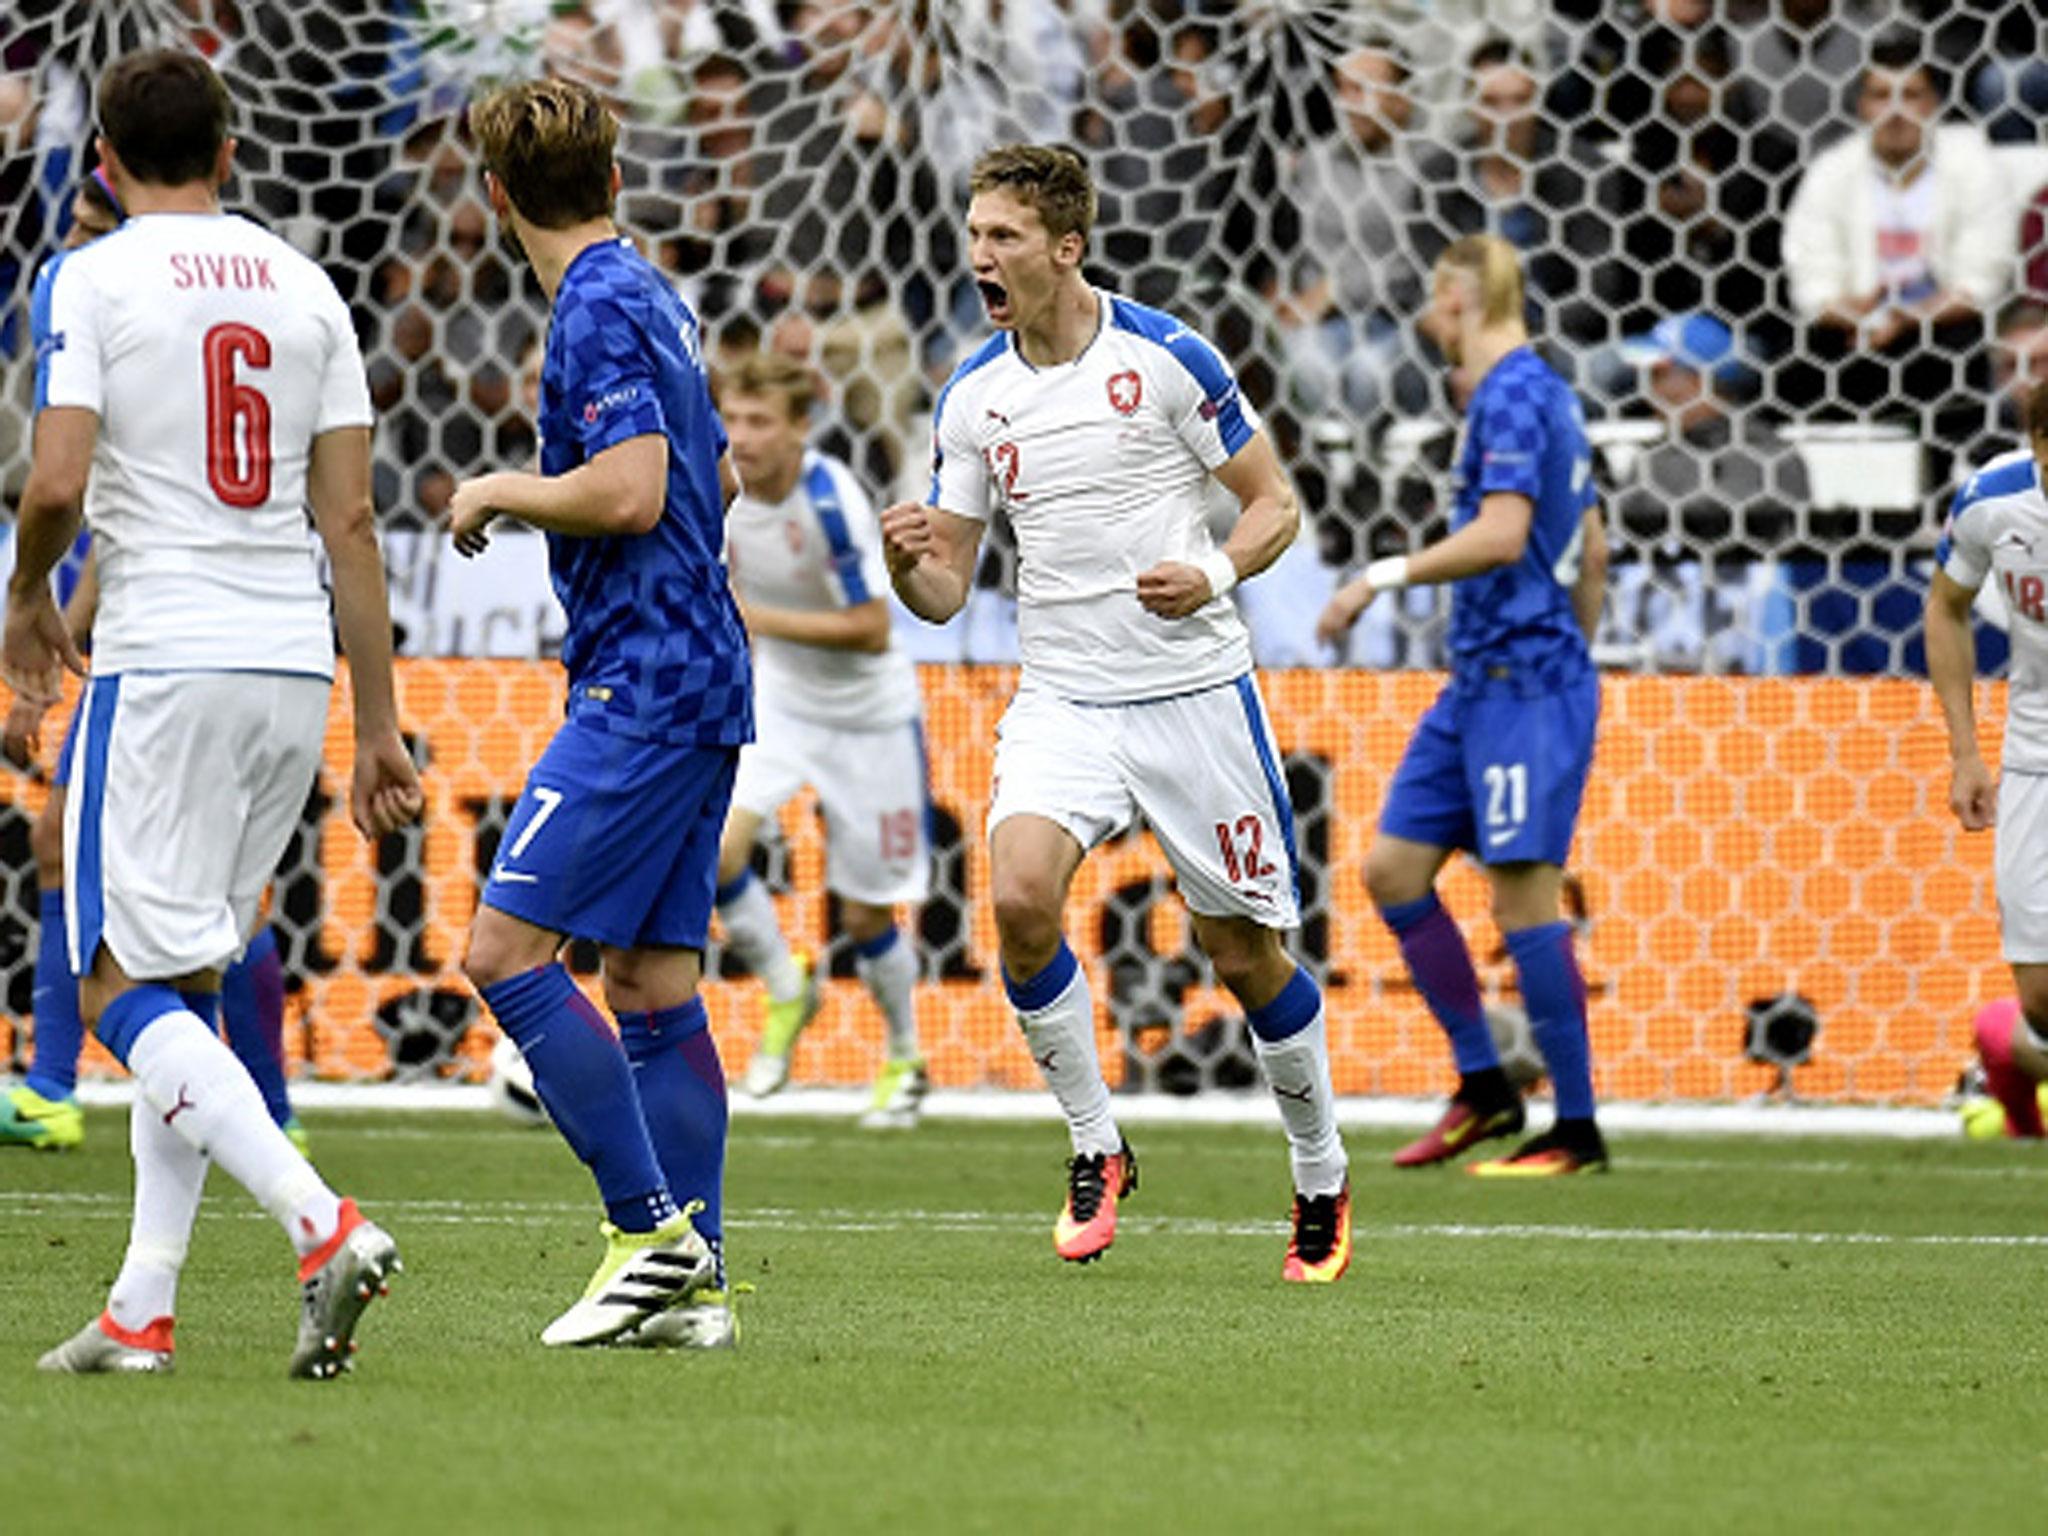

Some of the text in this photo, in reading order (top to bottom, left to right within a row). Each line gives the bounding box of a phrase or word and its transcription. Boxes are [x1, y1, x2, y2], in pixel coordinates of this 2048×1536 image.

[169, 253, 277, 291] SIVOK
[203, 321, 272, 509] 6
[508, 786, 564, 860] 7
[1482, 763, 1527, 825] 21
[1214, 814, 1277, 884] 12
